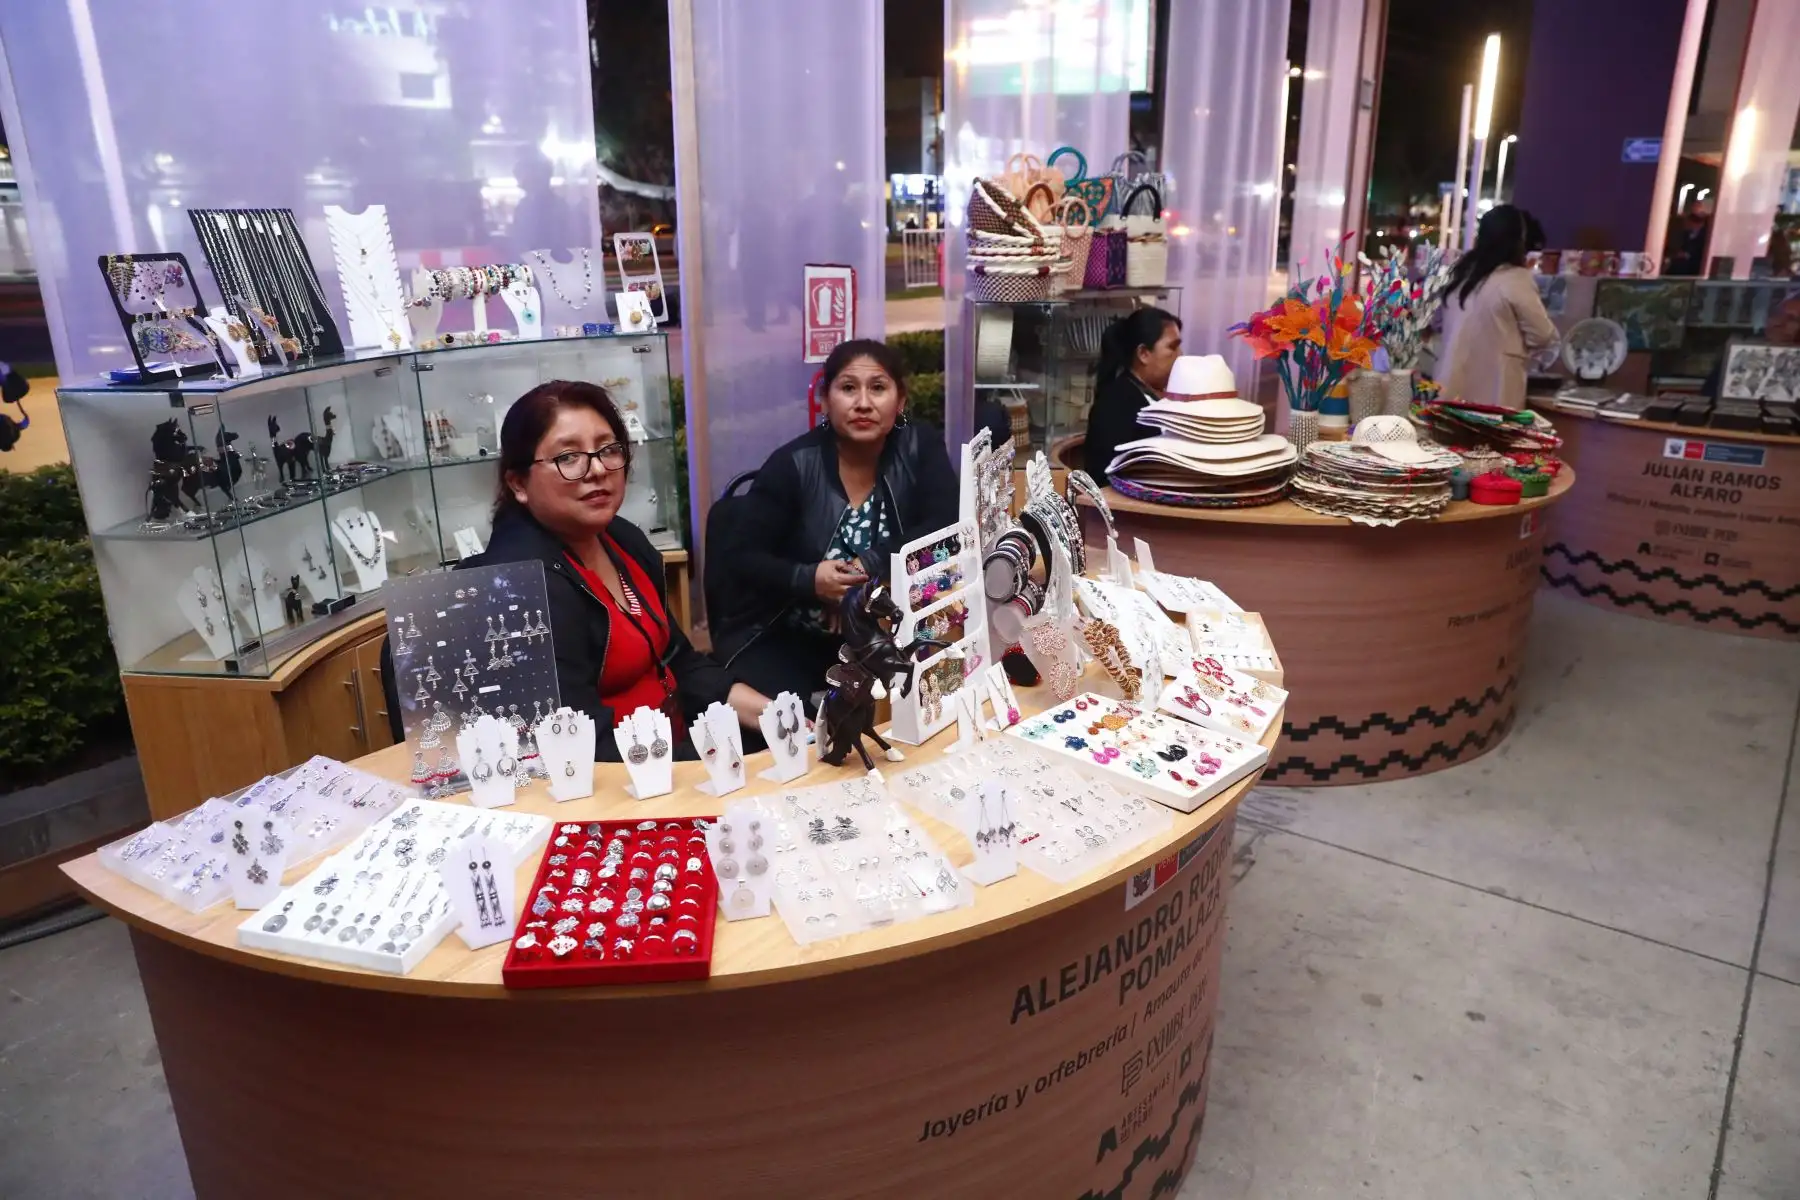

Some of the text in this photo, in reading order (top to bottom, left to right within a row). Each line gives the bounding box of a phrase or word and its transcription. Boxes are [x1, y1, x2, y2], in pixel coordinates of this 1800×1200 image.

[1669, 482, 1743, 504] ALFARO
[1709, 470, 1782, 490] RAMOS
[1010, 889, 1183, 1025] ALEJANDRO
[1119, 877, 1220, 1006] POMALAZA
[917, 1092, 1010, 1142] Joyería
[1015, 1084, 1029, 1110] y
[1034, 1022, 1128, 1094] orfebrería
